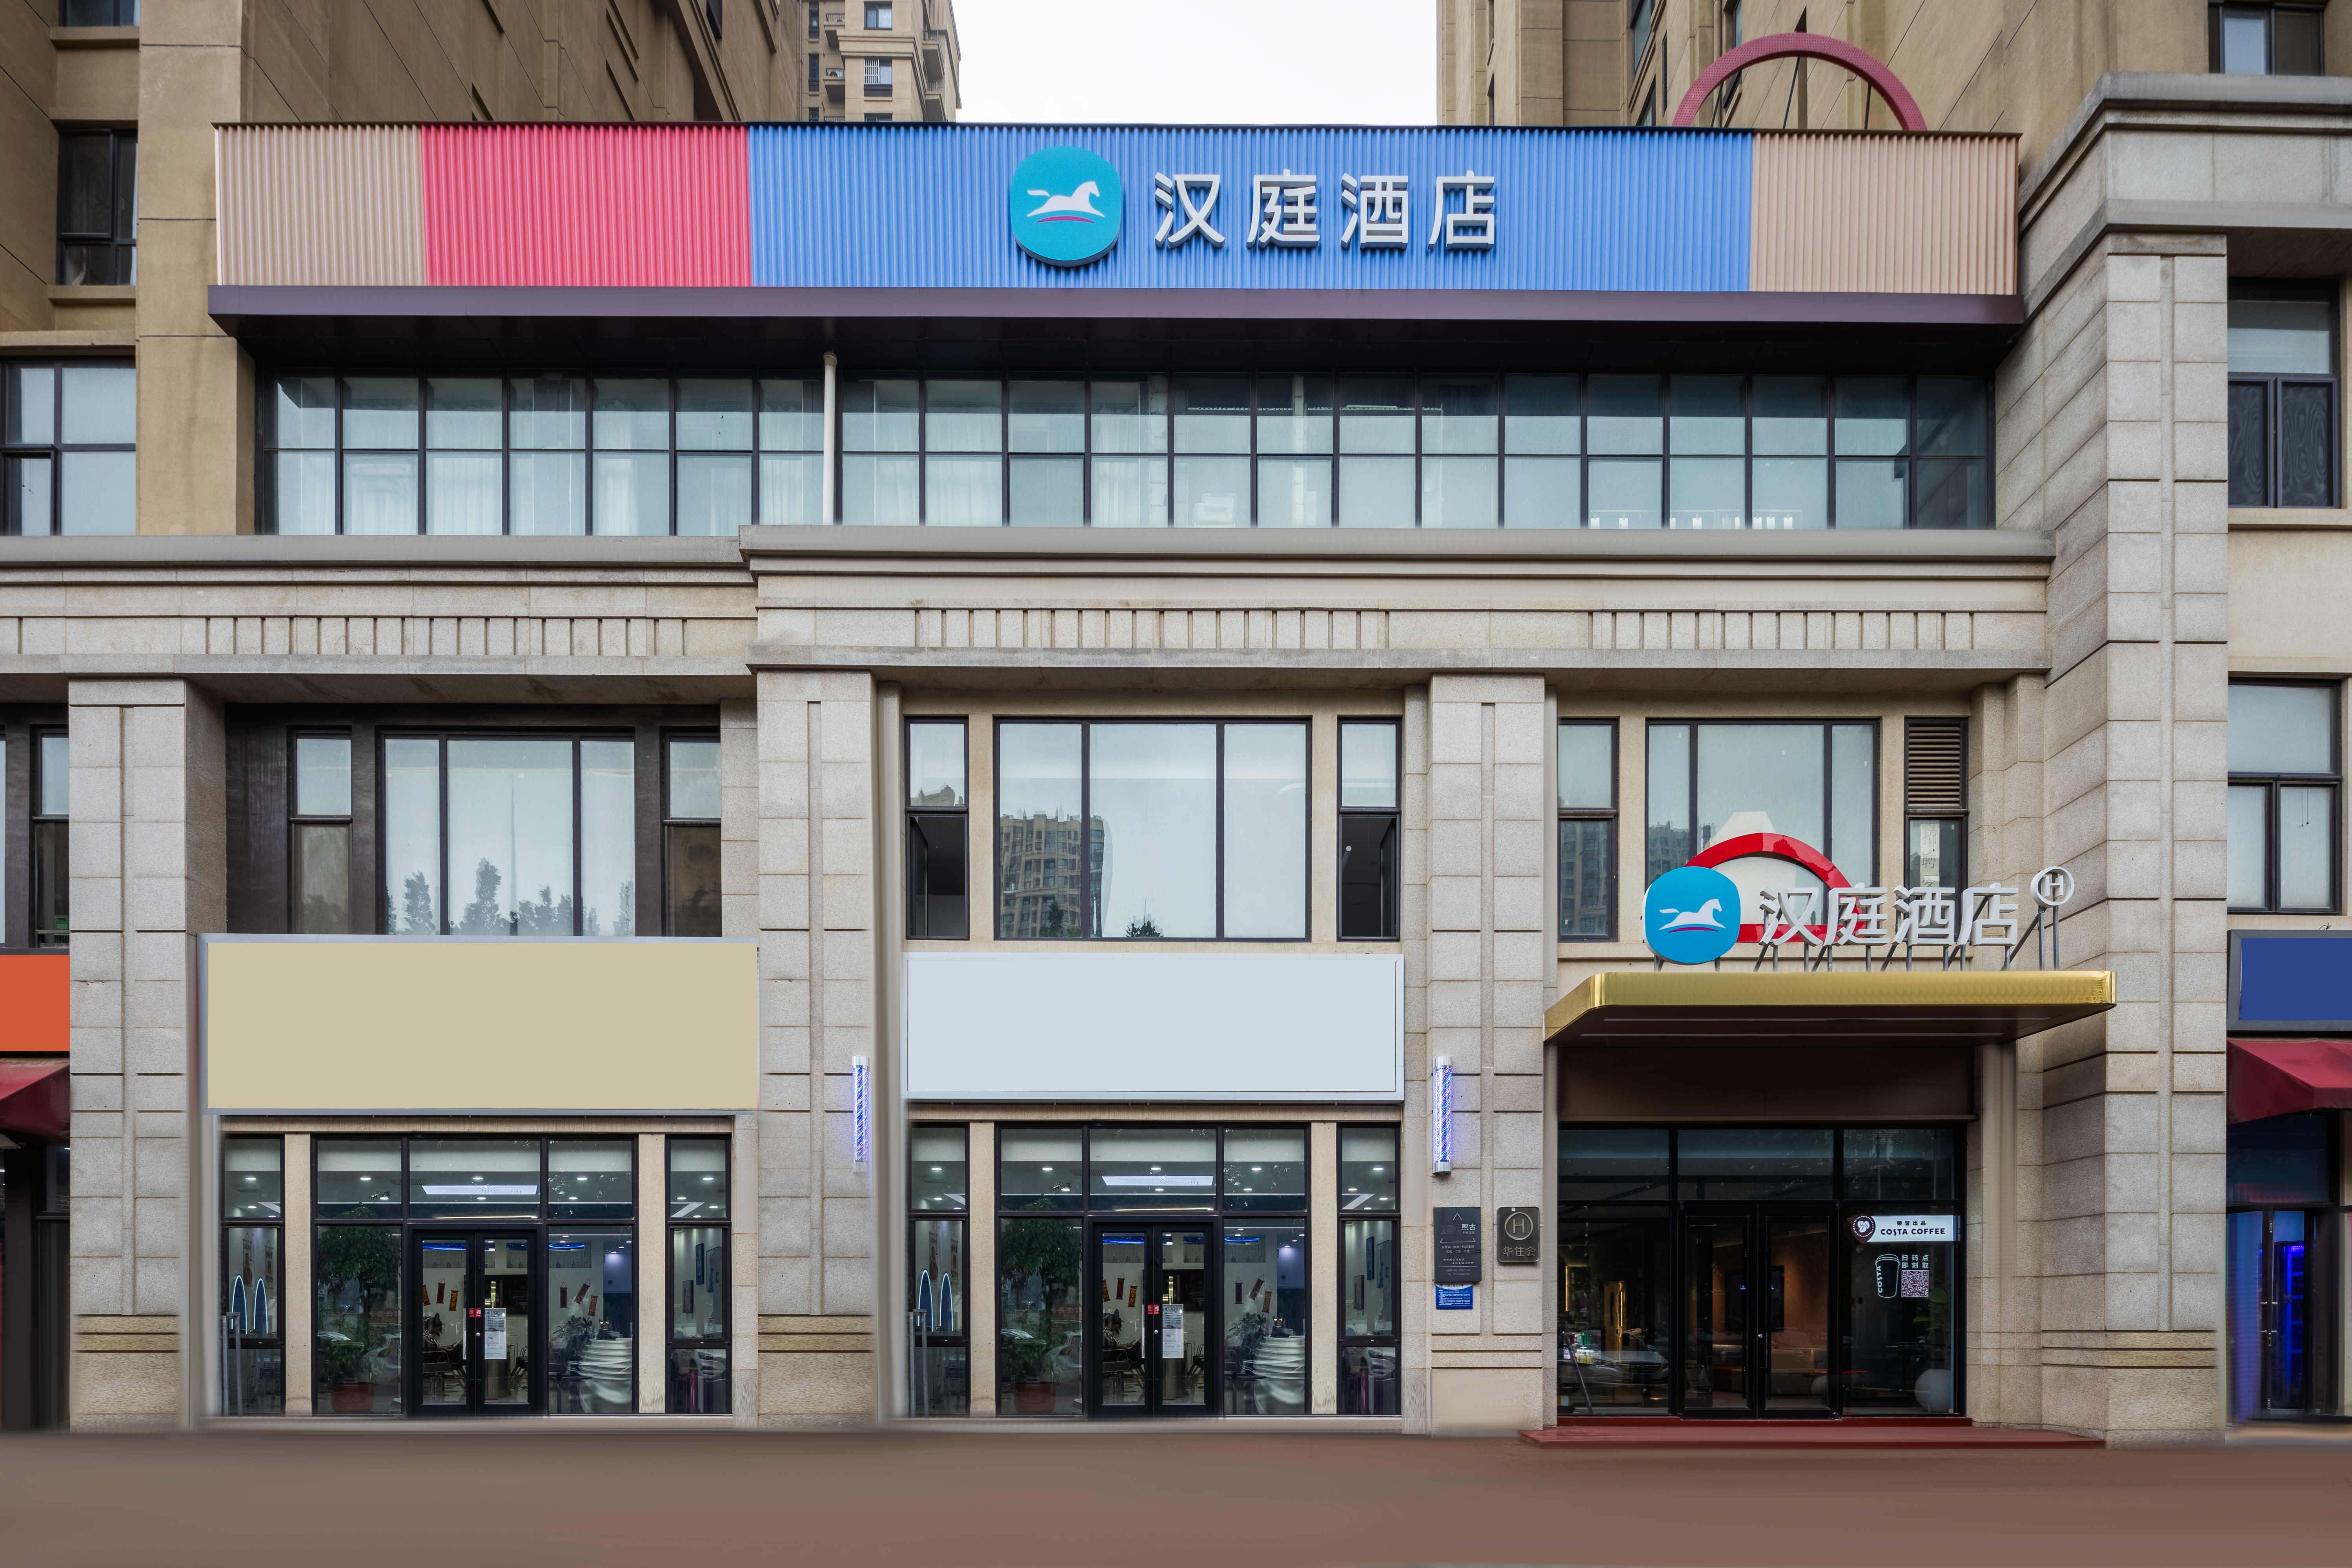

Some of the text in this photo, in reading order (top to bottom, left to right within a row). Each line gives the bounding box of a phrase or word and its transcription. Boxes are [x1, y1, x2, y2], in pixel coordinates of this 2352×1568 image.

[1154, 169, 1495, 249] 汉庭酒店
[1759, 882, 2019, 947] 汉庭酒店
[1513, 1219, 1525, 1233] H
[1503, 1246, 1536, 1257] 华住会
